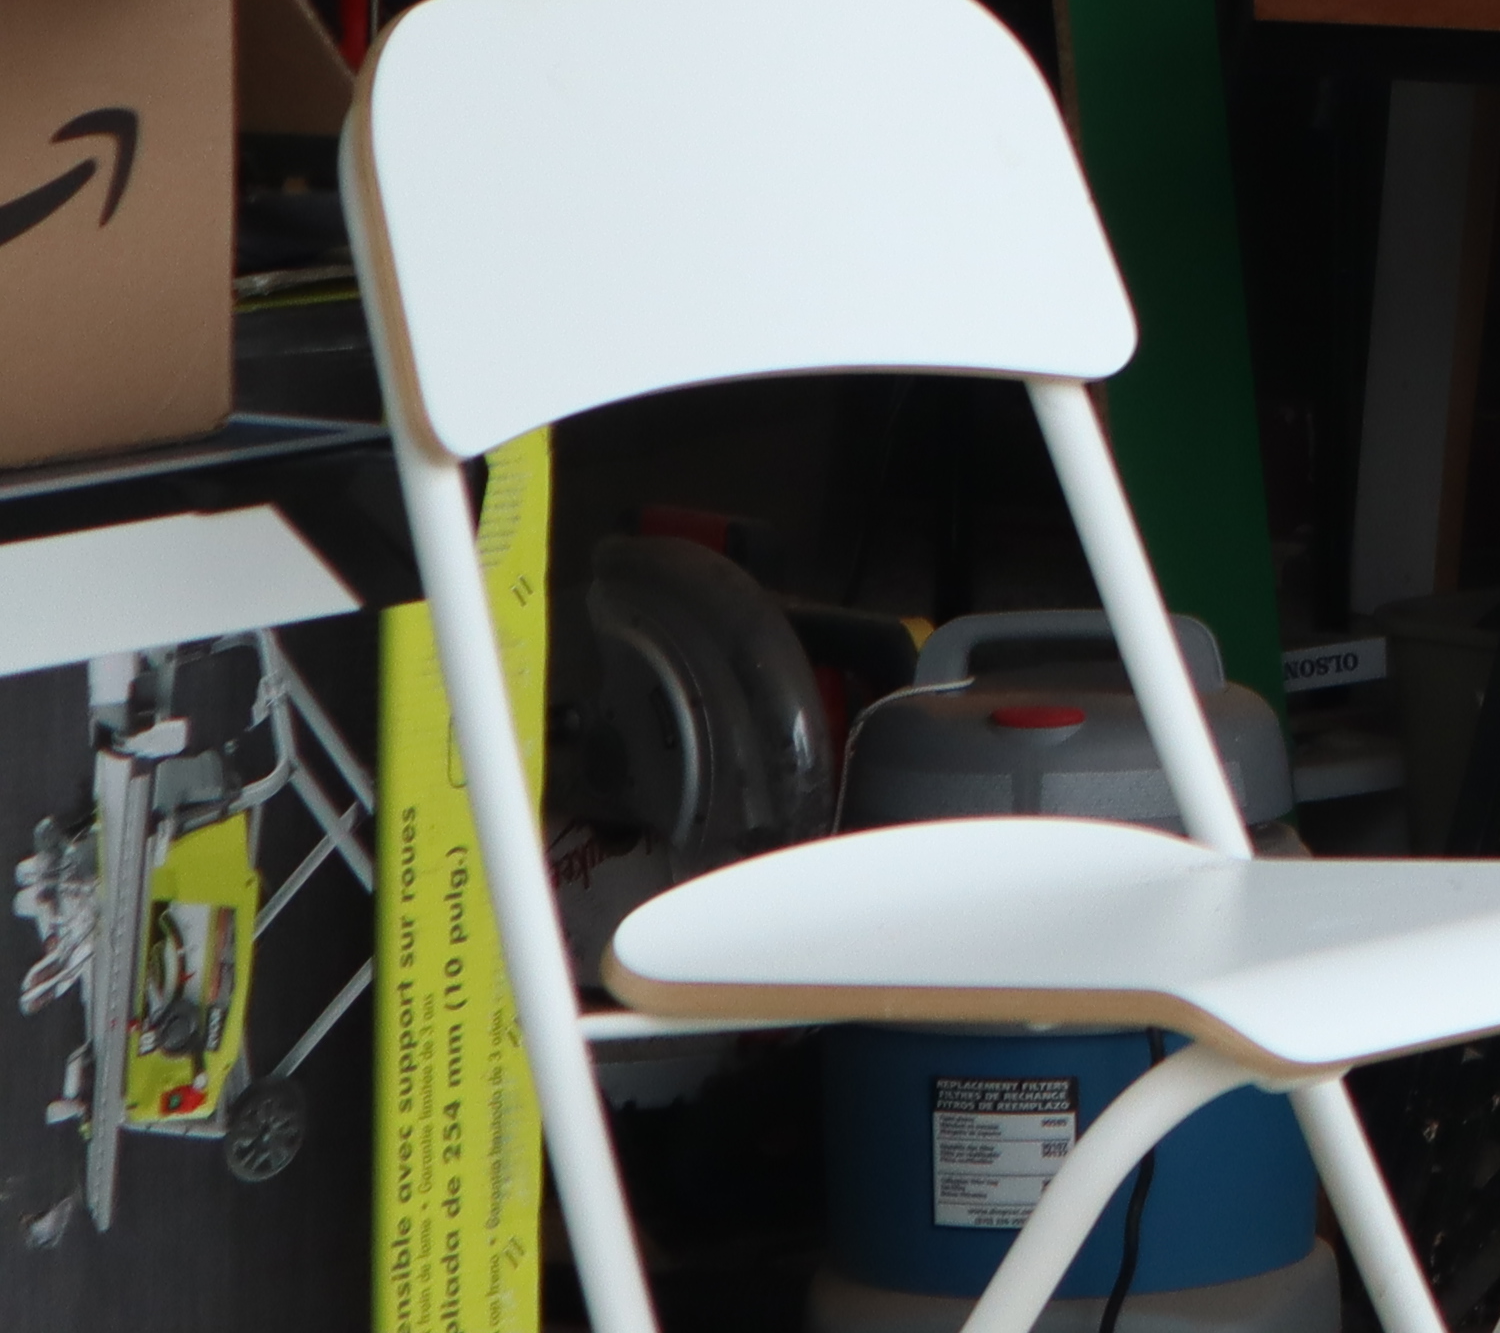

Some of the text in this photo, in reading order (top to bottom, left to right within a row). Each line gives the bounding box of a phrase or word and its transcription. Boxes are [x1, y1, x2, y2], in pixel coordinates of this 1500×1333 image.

[1284, 652, 1359, 681] OLSON
[400, 805, 417, 903] roues
[443, 844, 469, 946] pulg.)
[399, 914, 415, 970] sur
[444, 957, 468, 1011] (10
[396, 981, 418, 1114] support
[448, 1022, 462, 1089] mm
[936, 1080, 1070, 1091] REPLACEMENT FILTERS
[978, 1101, 993, 1110] DE
[996, 1101, 1070, 1110] REEMPLAZO
[985, 1091, 1000, 1101] DE
[1003, 1091, 1067, 1101] RECHANGE
[442, 1098, 462, 1167] 254
[398, 1125, 413, 1204] avec
[441, 1174, 462, 1219] de
